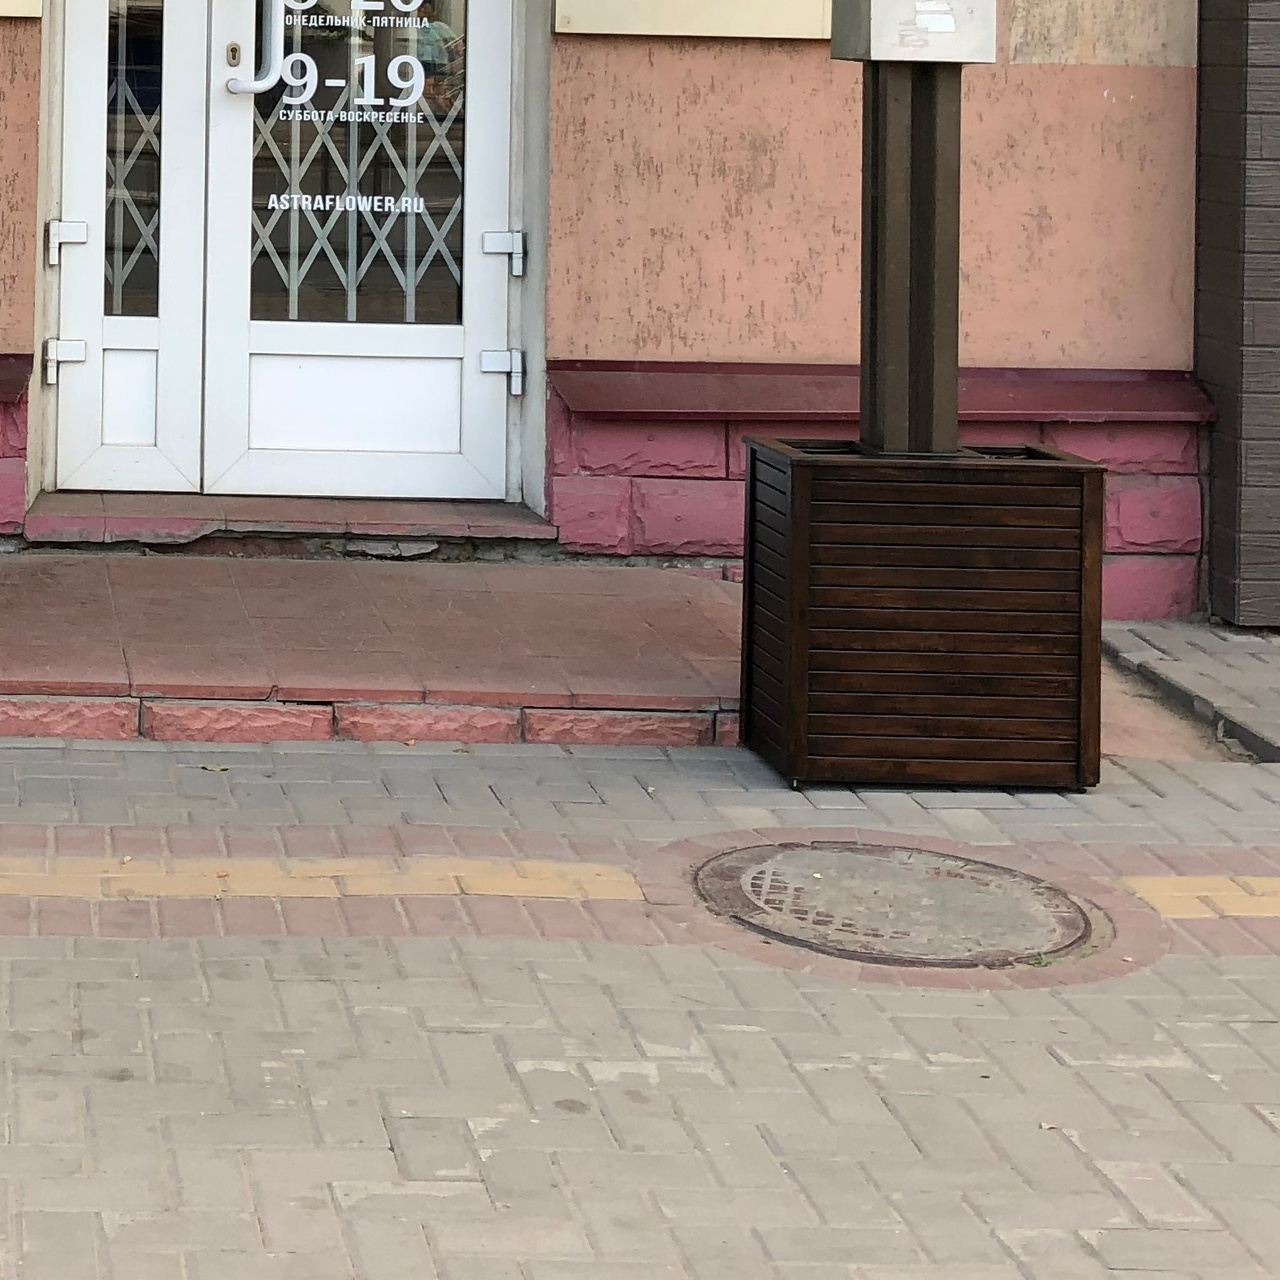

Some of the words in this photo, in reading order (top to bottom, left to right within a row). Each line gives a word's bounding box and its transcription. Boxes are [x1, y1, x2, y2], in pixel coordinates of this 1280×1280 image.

[284, 14, 430, 29] ОНЕДЕЛЬНИК-ПЯТНИЦА
[280, 53, 426, 107] 9-19
[279, 109, 424, 124] СУББОТА-ВОСКРЕСЕНЬЕ
[267, 194, 425, 213] ASTRAFLOWER.RU
